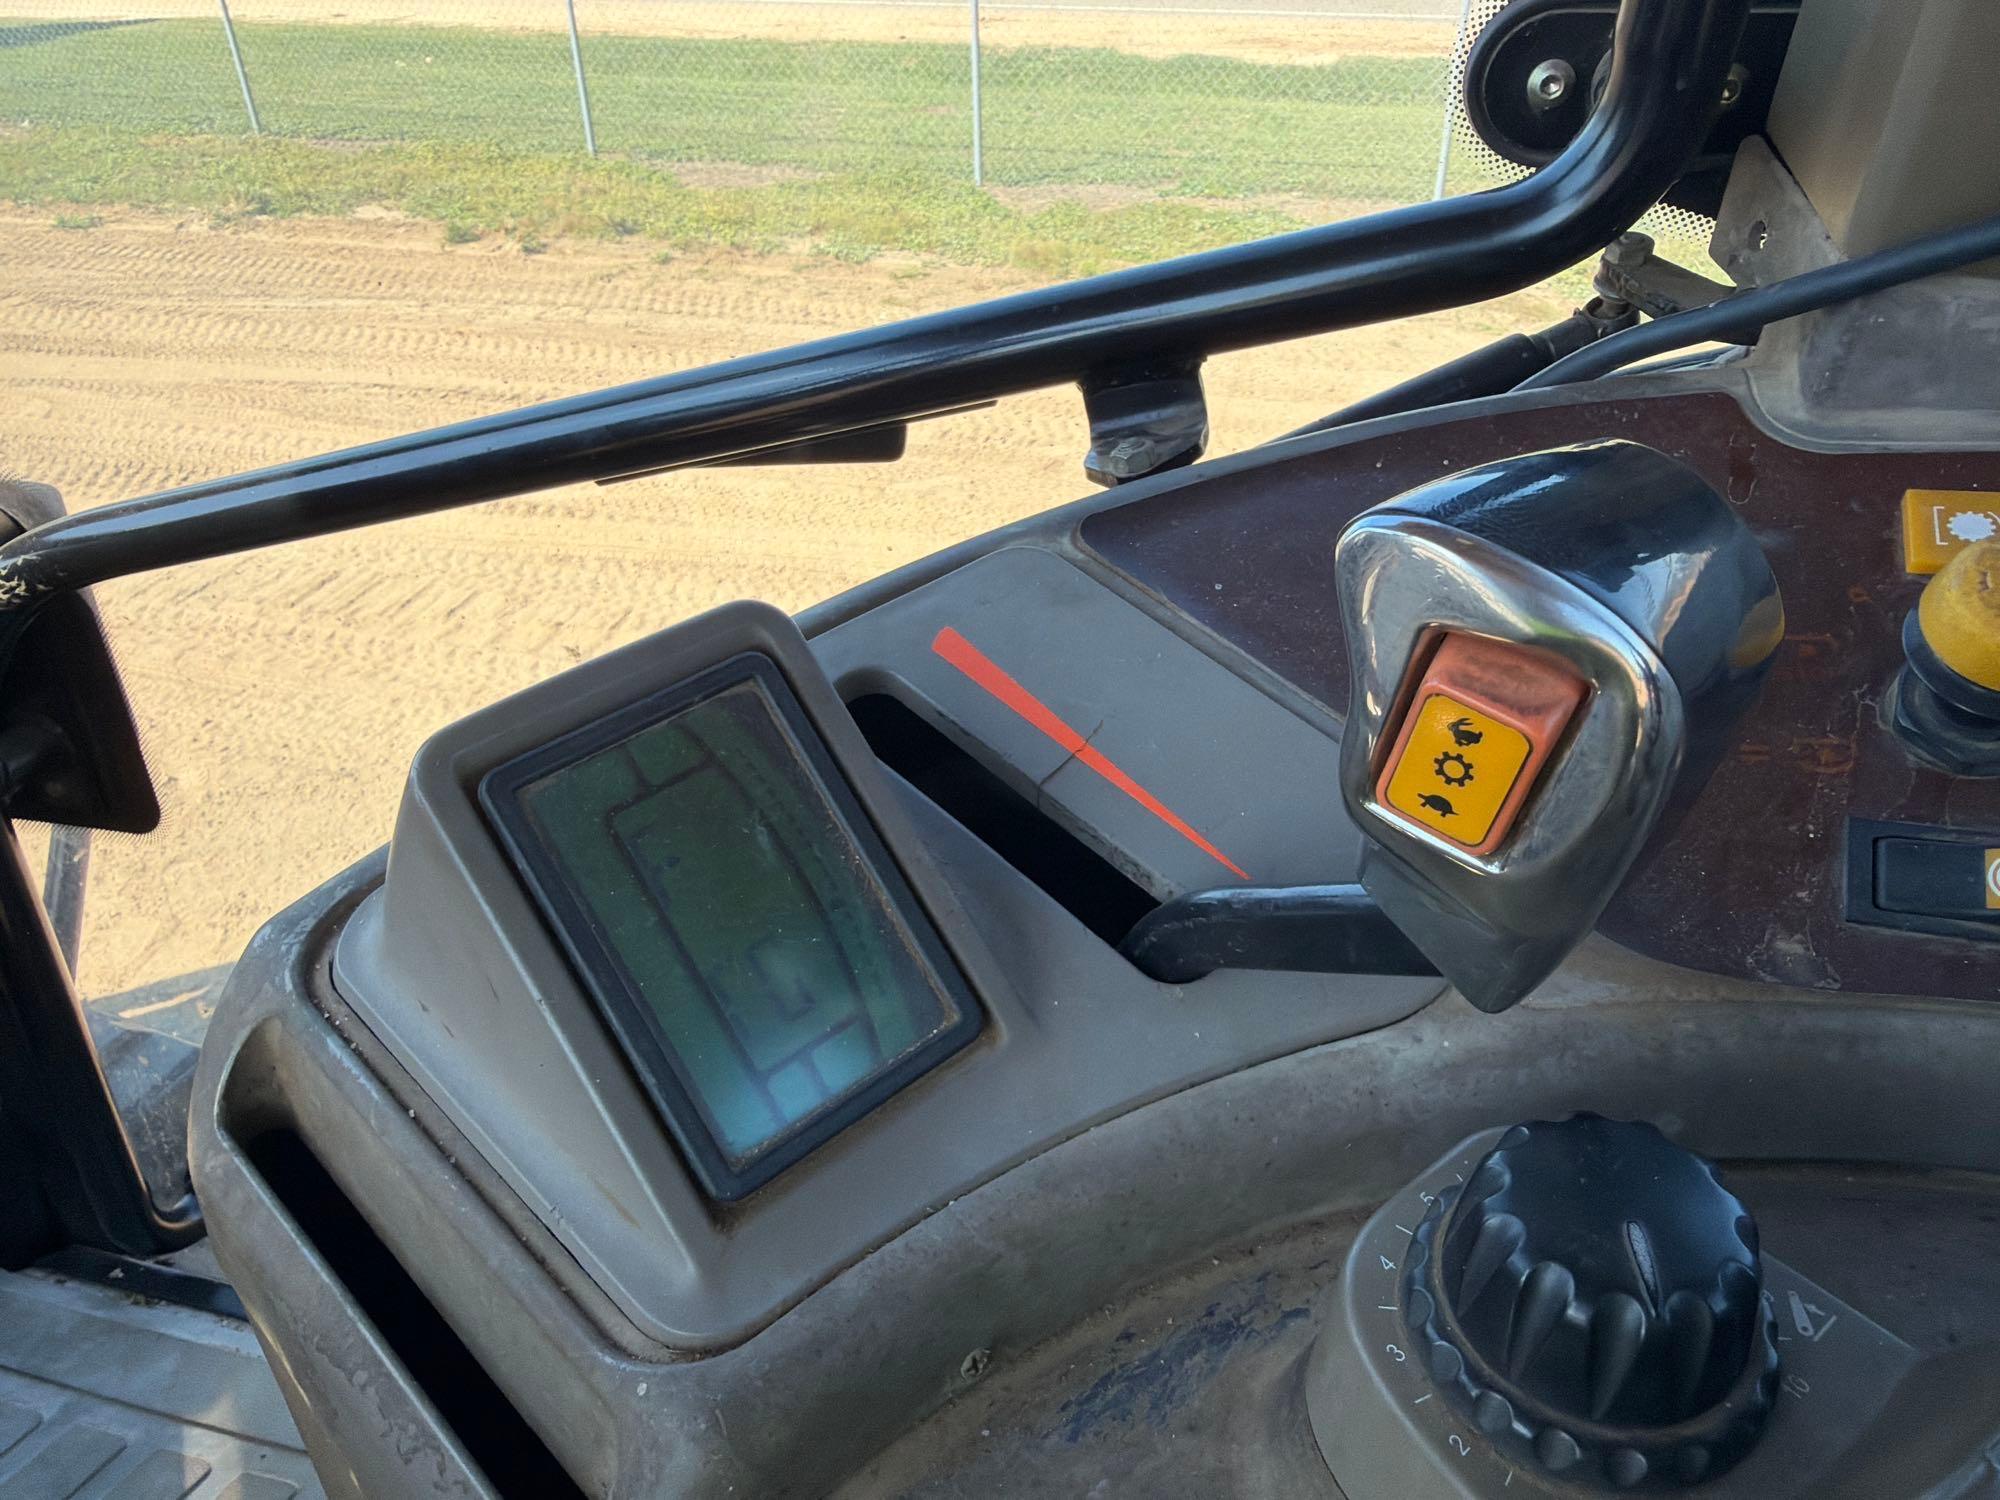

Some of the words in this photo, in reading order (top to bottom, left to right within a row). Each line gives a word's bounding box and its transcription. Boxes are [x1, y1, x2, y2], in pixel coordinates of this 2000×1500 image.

[1380, 1255, 1397, 1271] 4
[1386, 1344, 1405, 1362] 3
[1782, 1375, 1810, 1399] 10
[1449, 1434, 1471, 1456] 2
